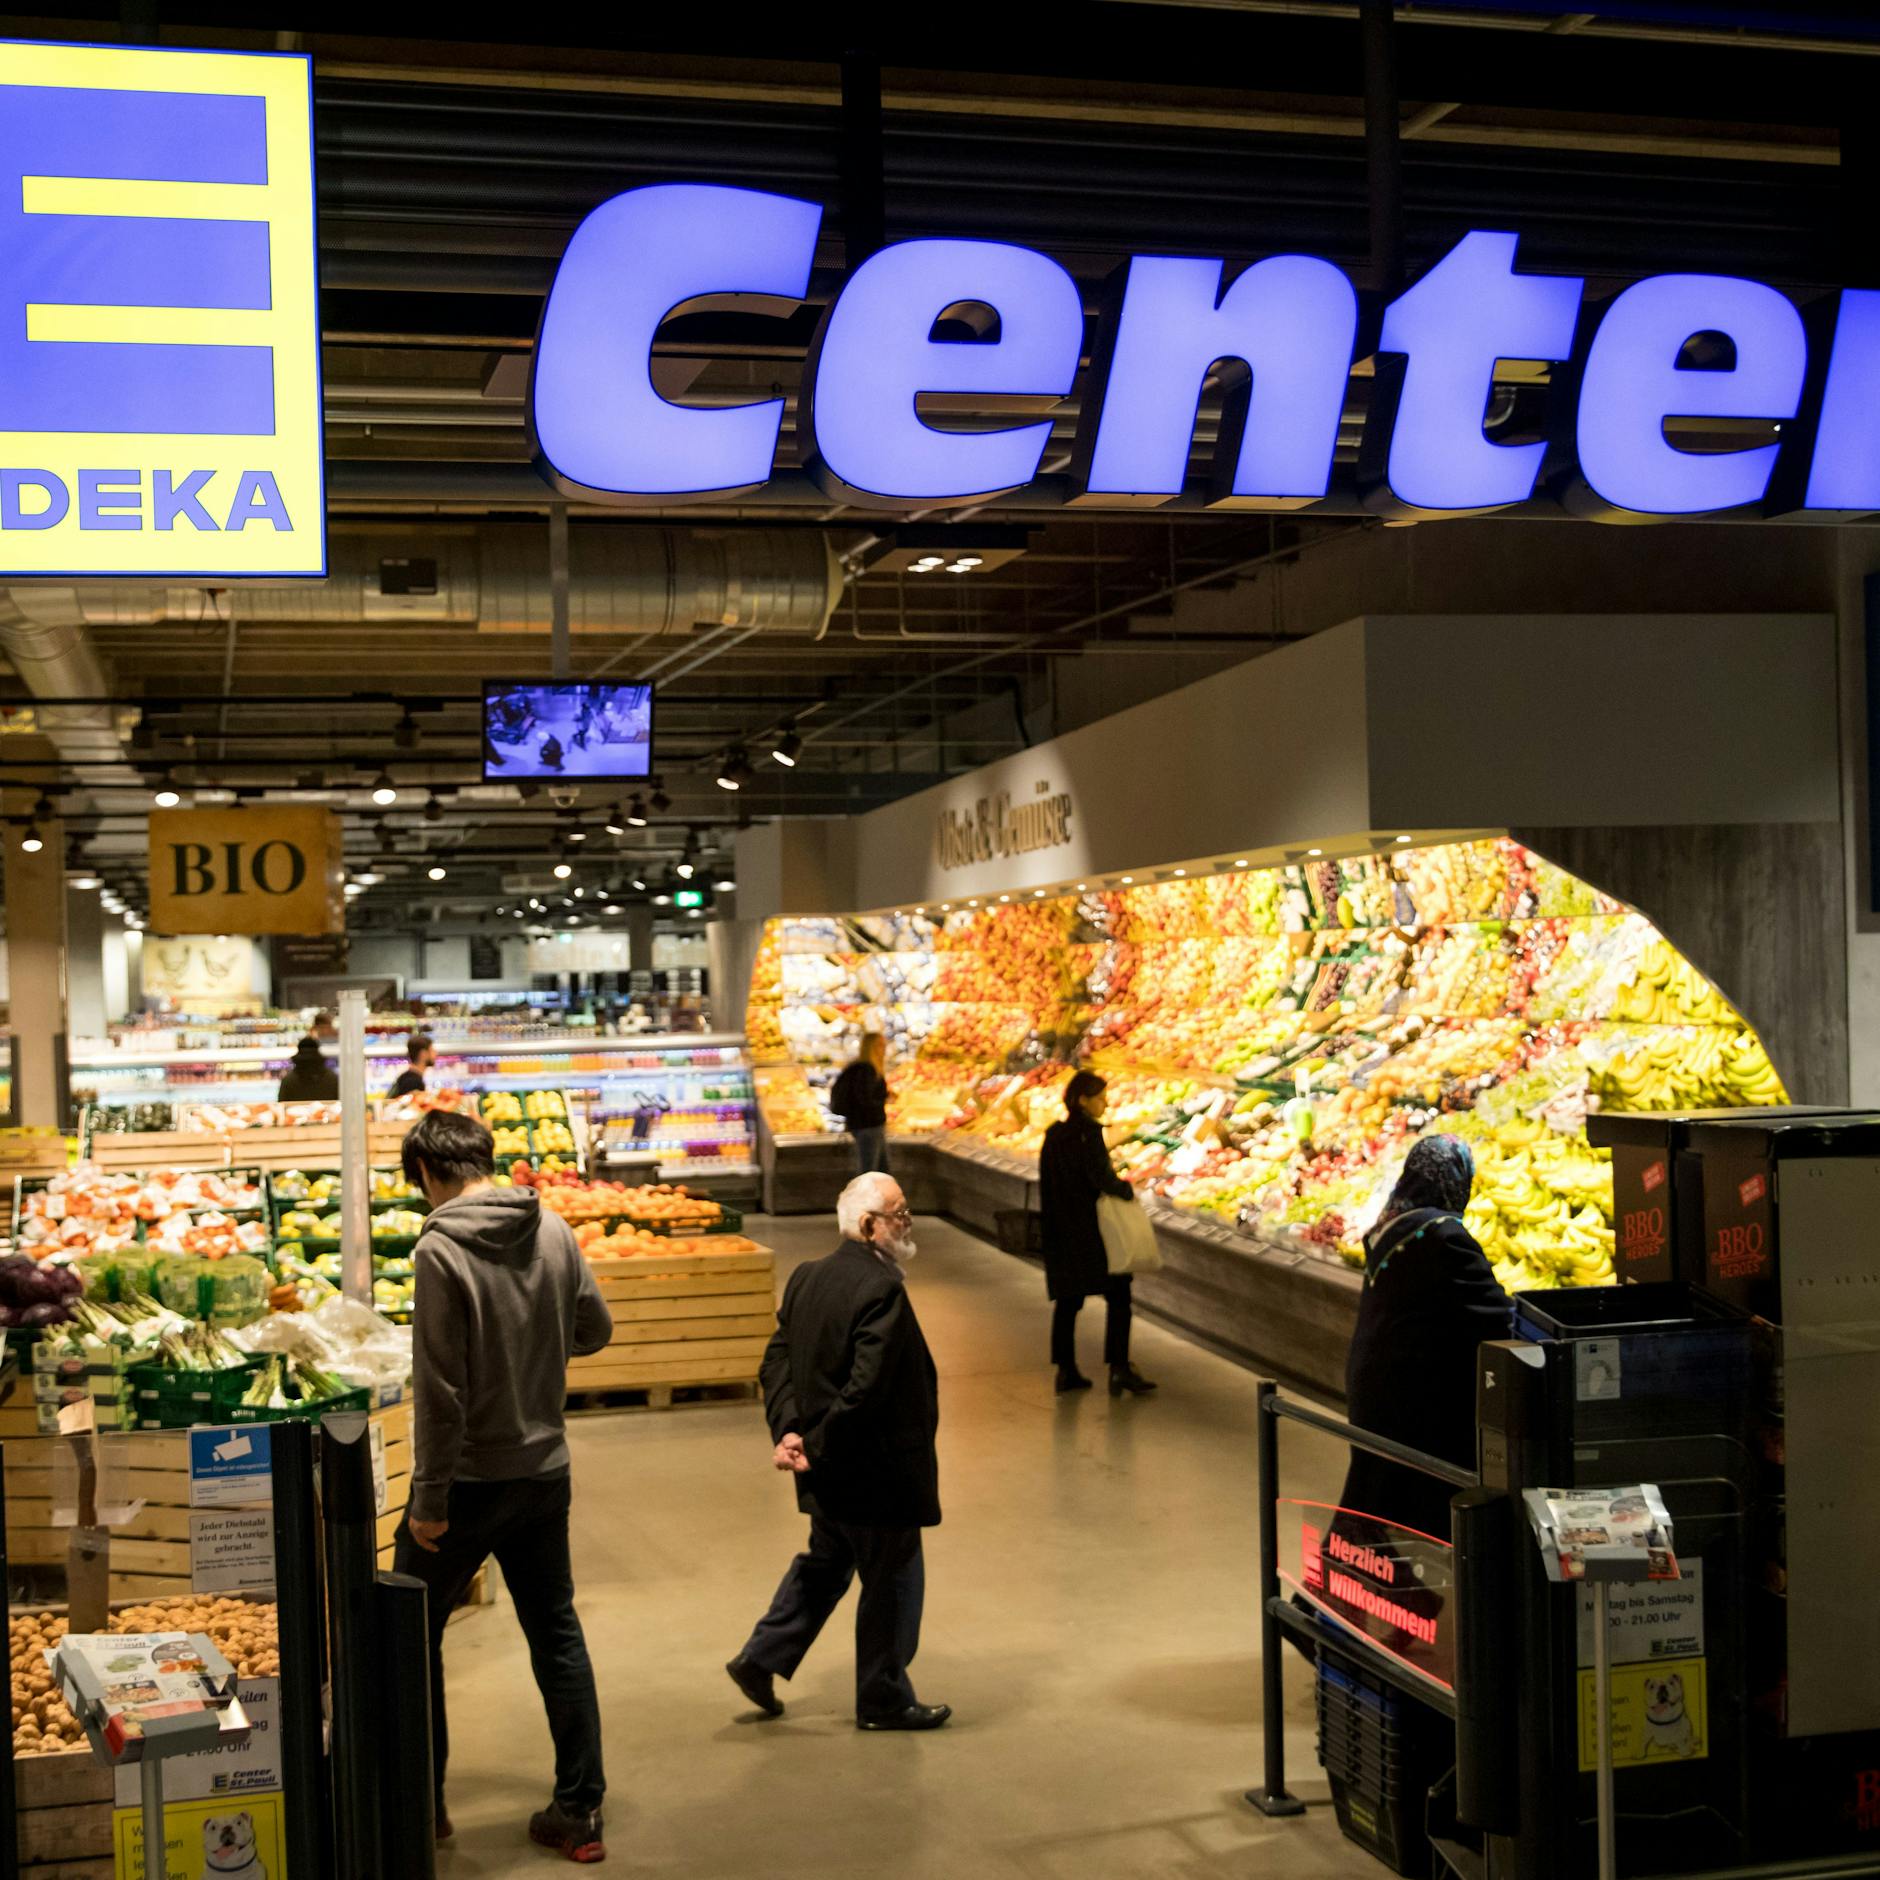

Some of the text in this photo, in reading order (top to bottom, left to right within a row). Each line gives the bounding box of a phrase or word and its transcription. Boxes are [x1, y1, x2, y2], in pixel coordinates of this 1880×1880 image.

[168, 839, 307, 897] BIO
[1623, 1207, 1664, 1242] BBQ
[1717, 1222, 1764, 1260] BBQ
[1625, 1244, 1661, 1260] HEROES
[1719, 1261, 1761, 1280] HEROES
[200, 1518, 266, 1531] Jeder Diebstahl
[197, 1530, 269, 1542] wird zur Anzeige
[1328, 1531, 1395, 1585] Herzlich
[1328, 1569, 1438, 1646] Willkommen!
[1585, 1593, 1695, 1612] Mtag bis Samstag
[1631, 1614, 1659, 1626] 21.00
[1662, 1611, 1681, 1622] Uhr
[239, 1690, 268, 1703] eiten
[233, 1768, 272, 1778] Center
[247, 1775, 276, 1785] Pauli
